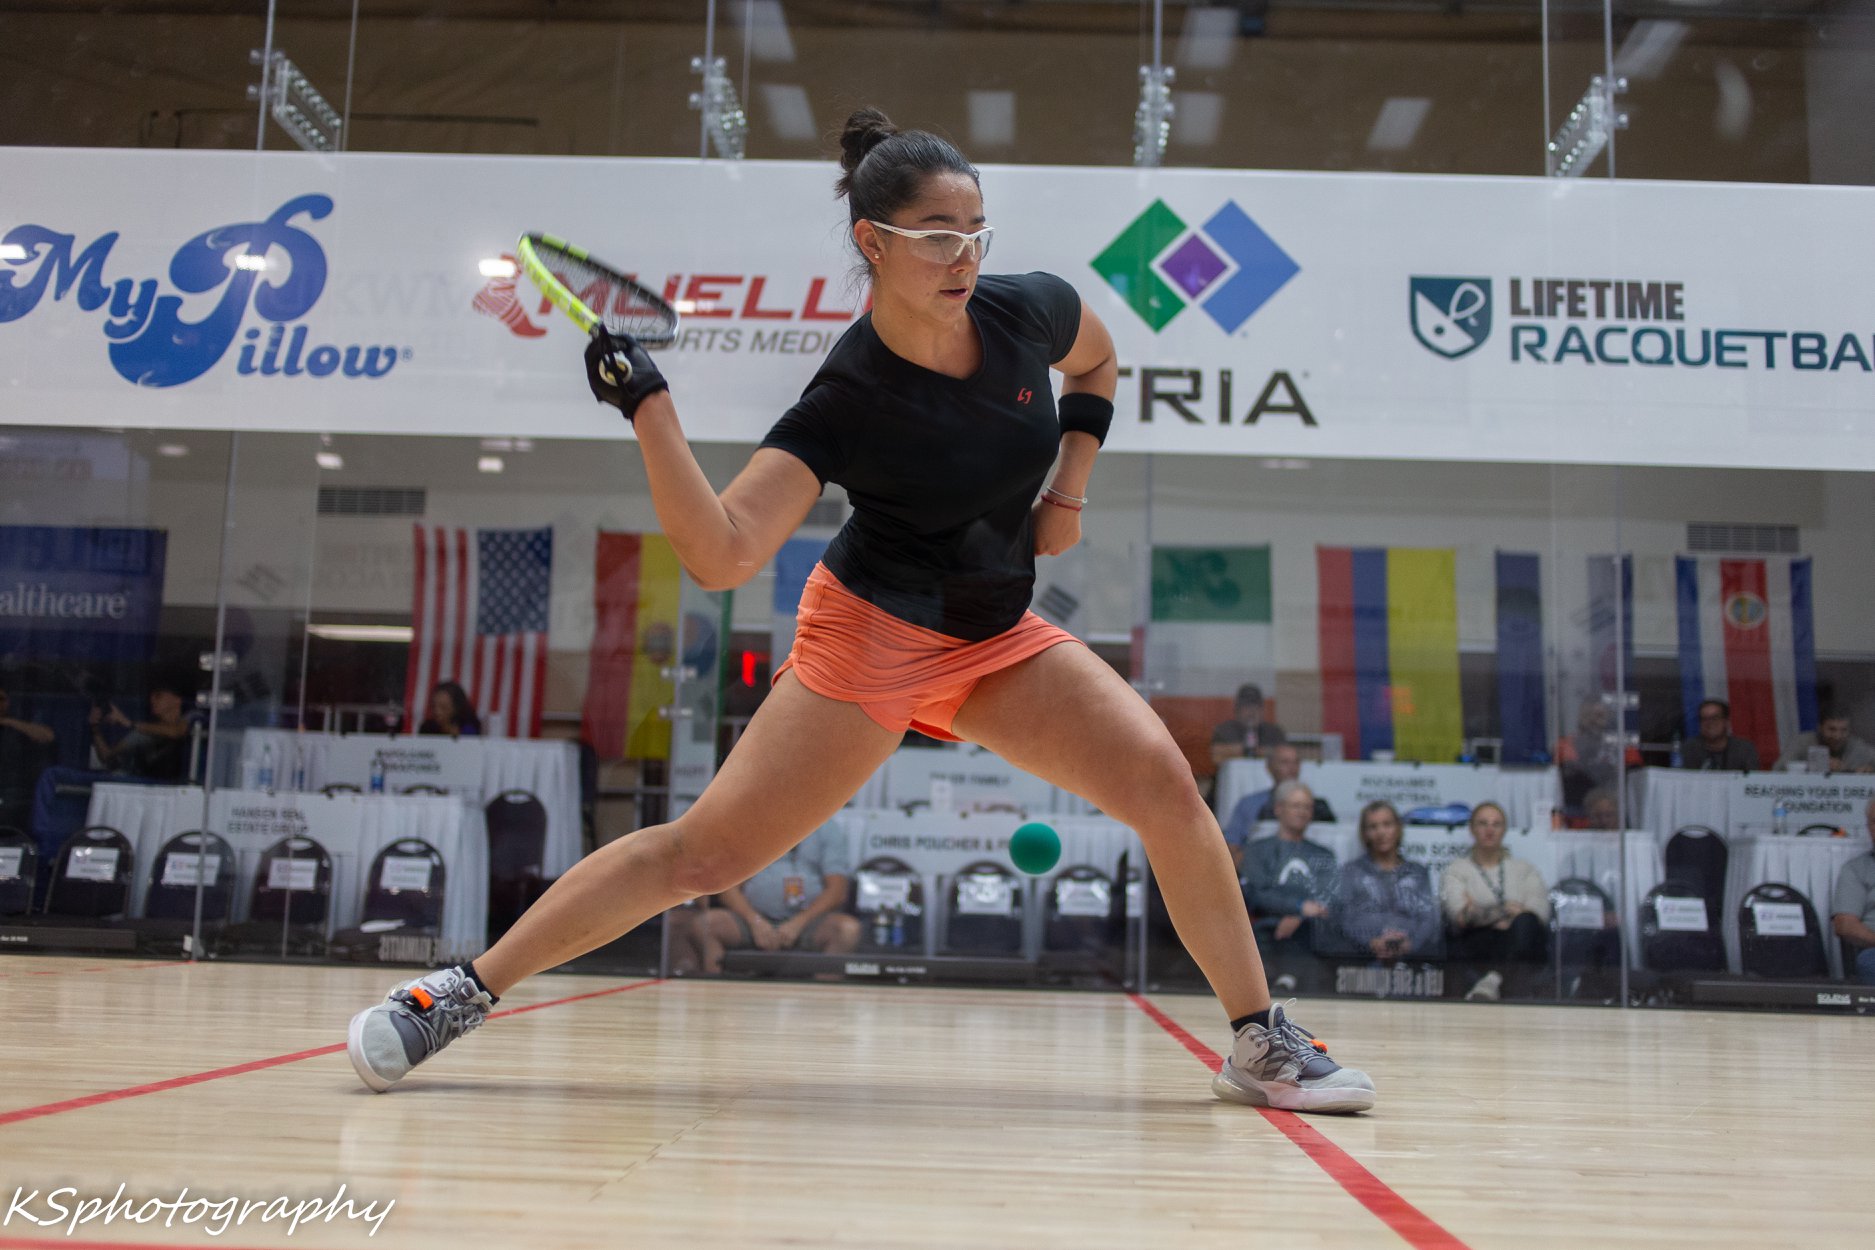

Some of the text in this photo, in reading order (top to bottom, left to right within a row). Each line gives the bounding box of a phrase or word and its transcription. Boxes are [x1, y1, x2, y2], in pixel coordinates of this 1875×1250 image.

[538, 271, 873, 321] MUELL
[1510, 278, 1684, 321] LIFETIME
[749, 331, 832, 354] MEDI
[1511, 325, 1875, 371] RACQUETBA
[1117, 367, 1319, 428] RIA
[1784, 801, 1852, 814] OUNDATION
[1808, 786, 1840, 798] YOUR
